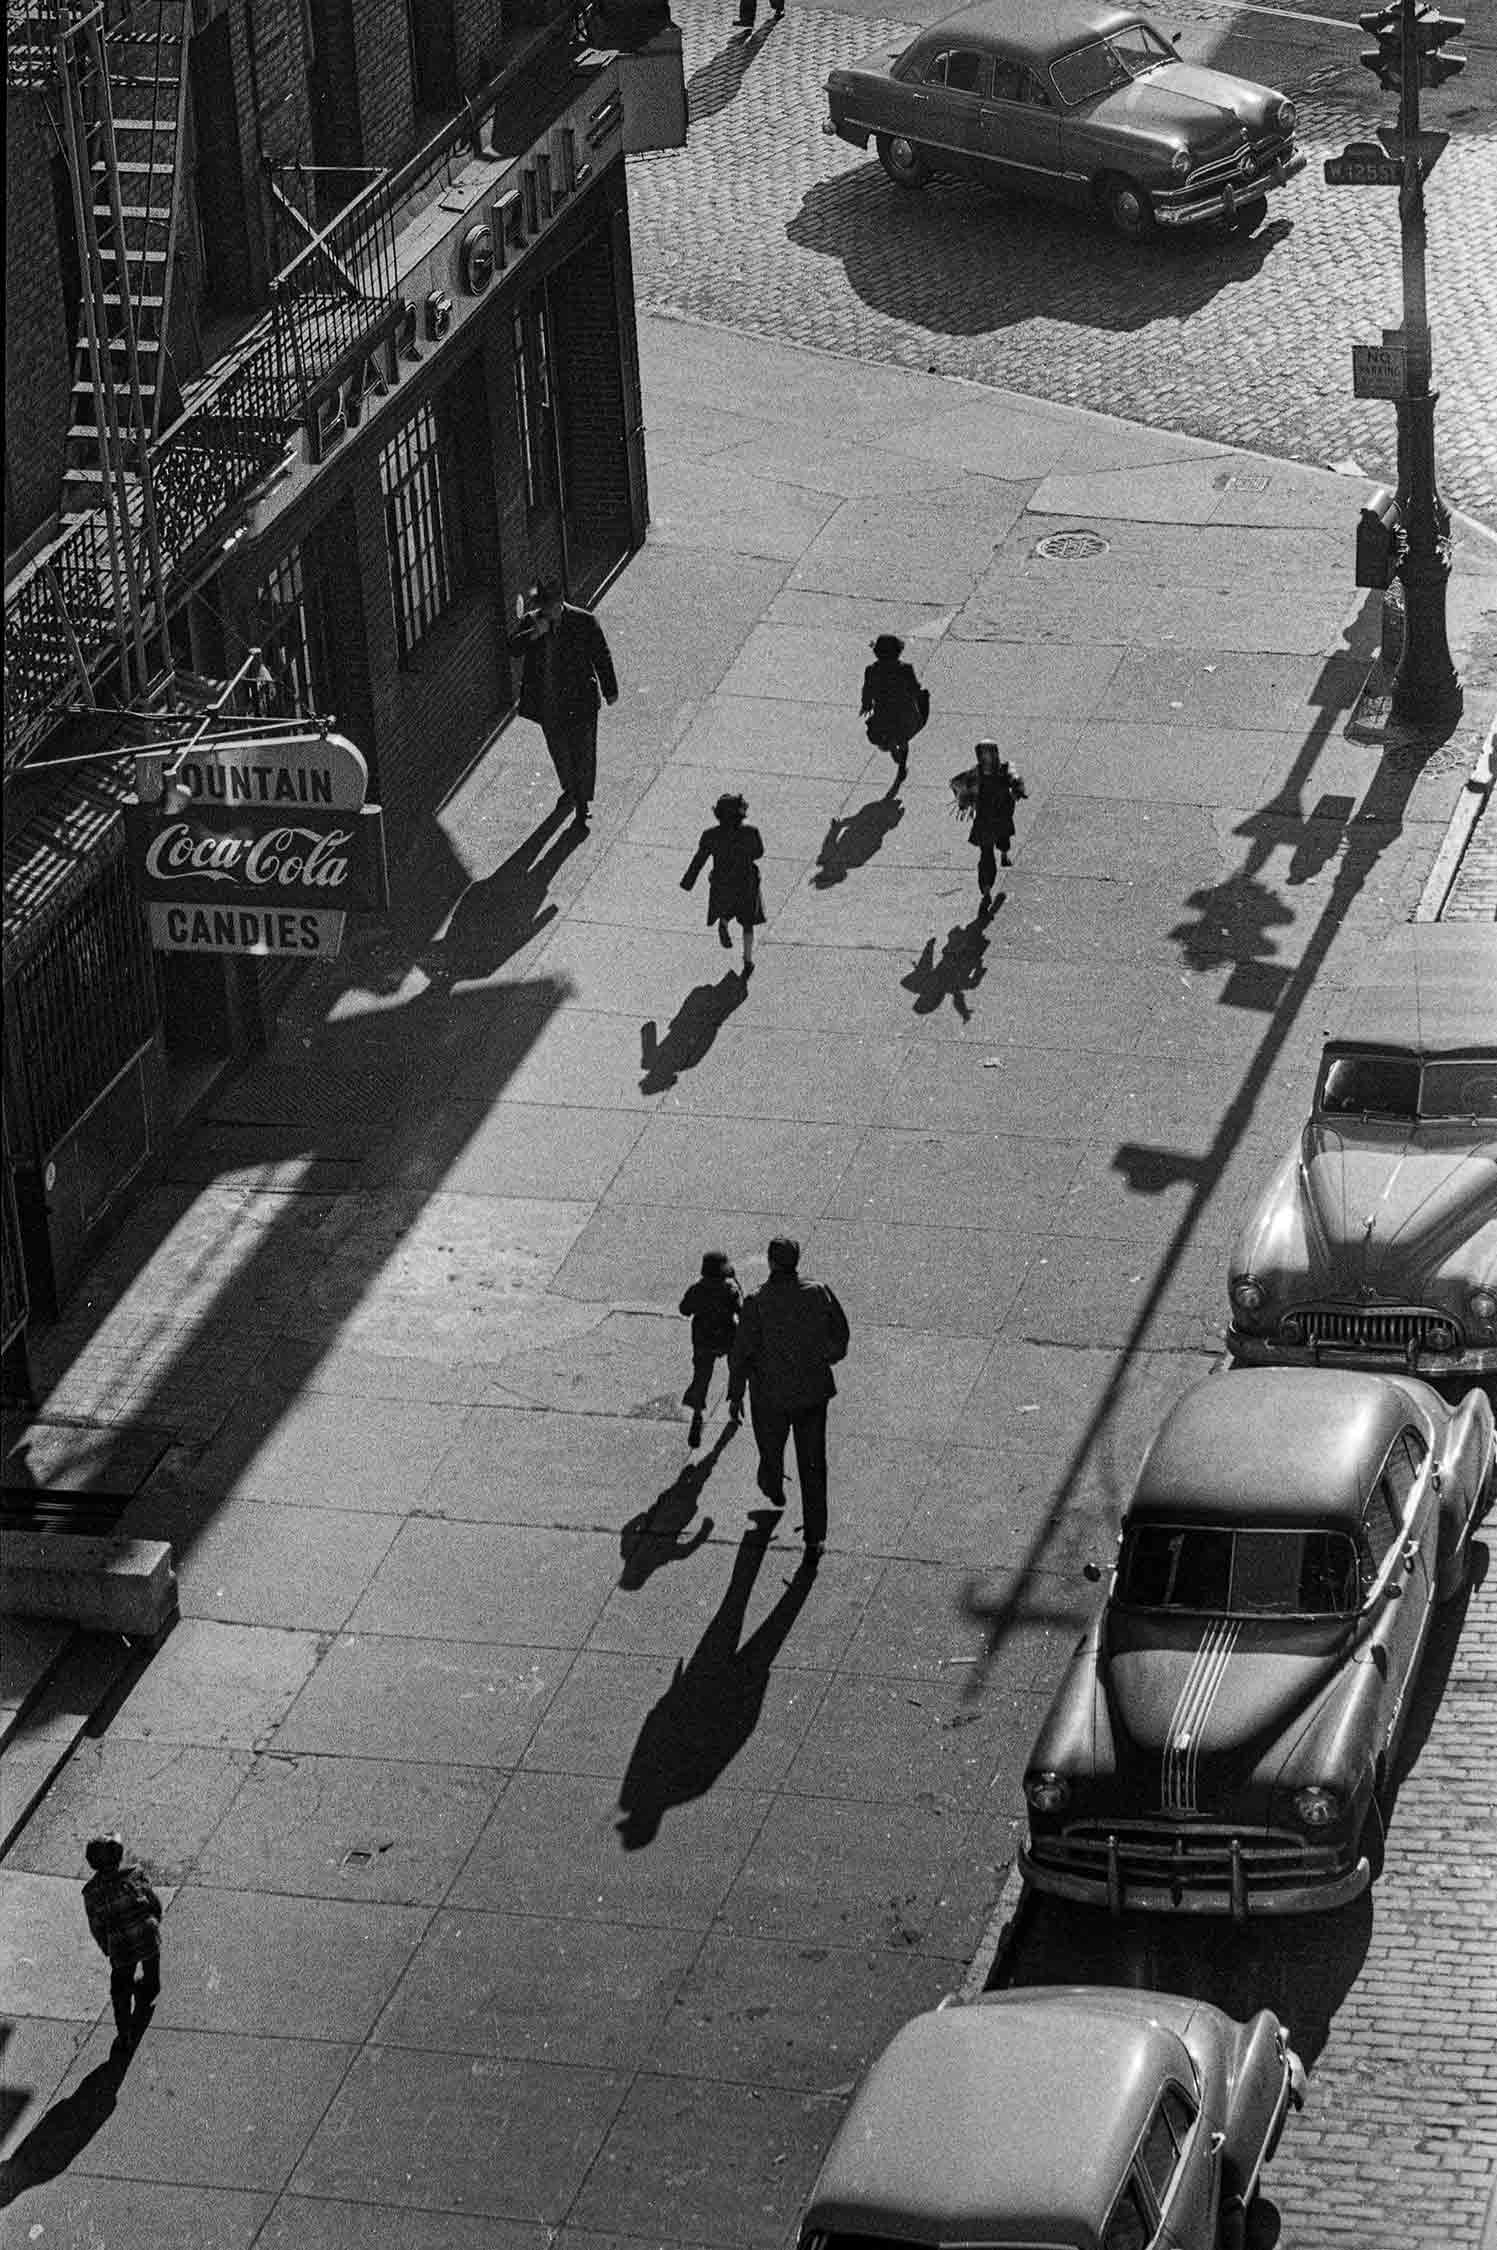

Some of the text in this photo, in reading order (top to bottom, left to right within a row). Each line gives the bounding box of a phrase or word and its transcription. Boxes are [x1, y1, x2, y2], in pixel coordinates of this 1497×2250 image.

[1367, 351, 1391, 364] NO
[146, 823, 355, 888] Coca-Cola
[166, 908, 321, 950] CANDIES
